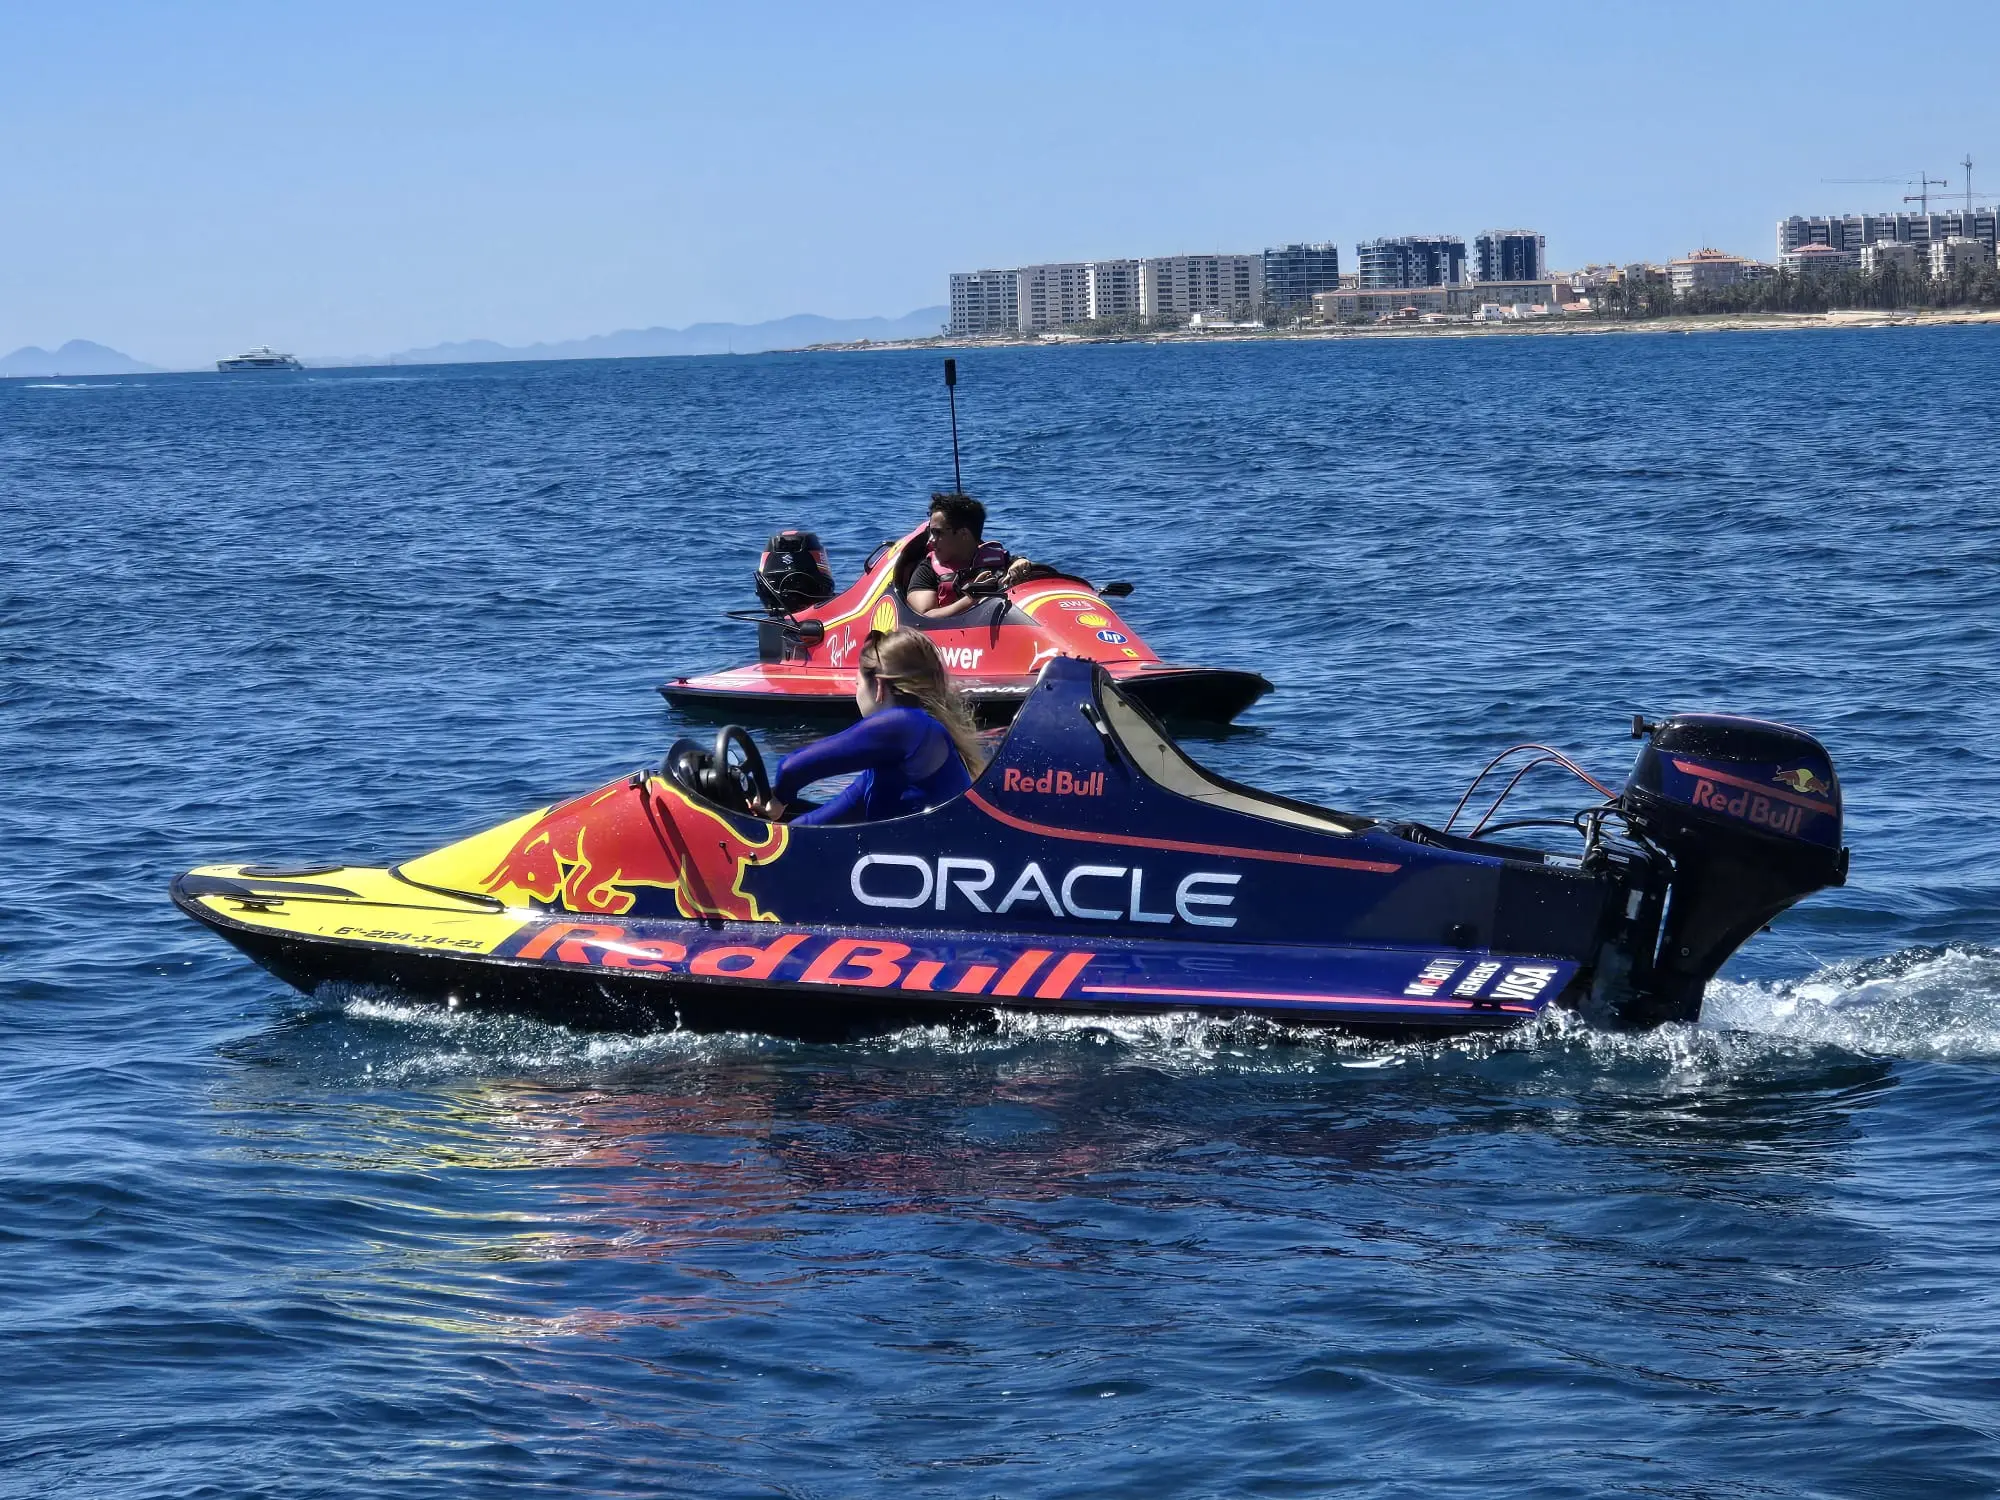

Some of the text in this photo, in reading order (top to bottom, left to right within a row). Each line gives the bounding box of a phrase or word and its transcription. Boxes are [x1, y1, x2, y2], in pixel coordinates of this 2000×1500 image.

[938, 646, 983, 669] wer
[1004, 768, 1104, 797] Red Bull
[1692, 779, 1804, 835] Red Bull
[850, 853, 1243, 928] ORACLE
[515, 922, 811, 981] Red
[800, 938, 1096, 1000] Bull
[1489, 967, 1559, 1000] VISA
